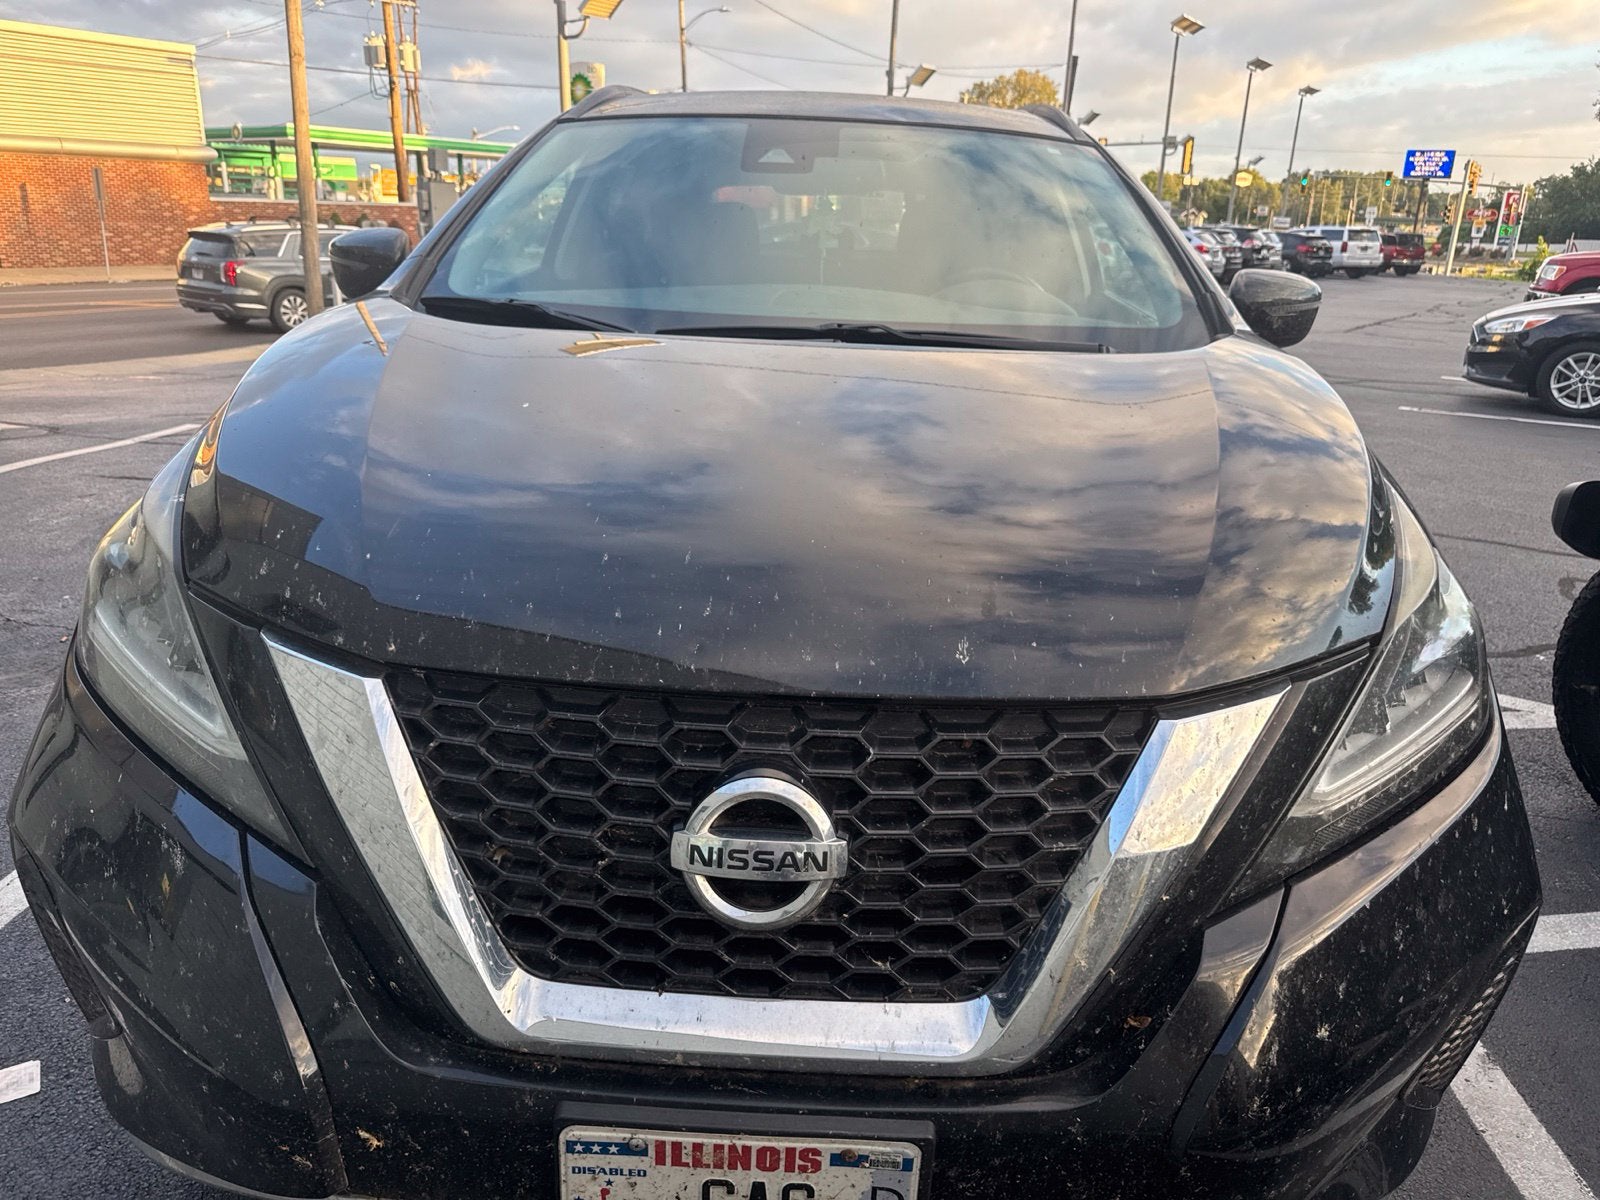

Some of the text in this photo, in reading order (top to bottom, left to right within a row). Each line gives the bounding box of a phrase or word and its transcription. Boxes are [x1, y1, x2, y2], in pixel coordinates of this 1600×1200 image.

[689, 844, 828, 873] NISSAN
[654, 1139, 823, 1174] ILLINOIS
[571, 1165, 648, 1178] DISABLED
